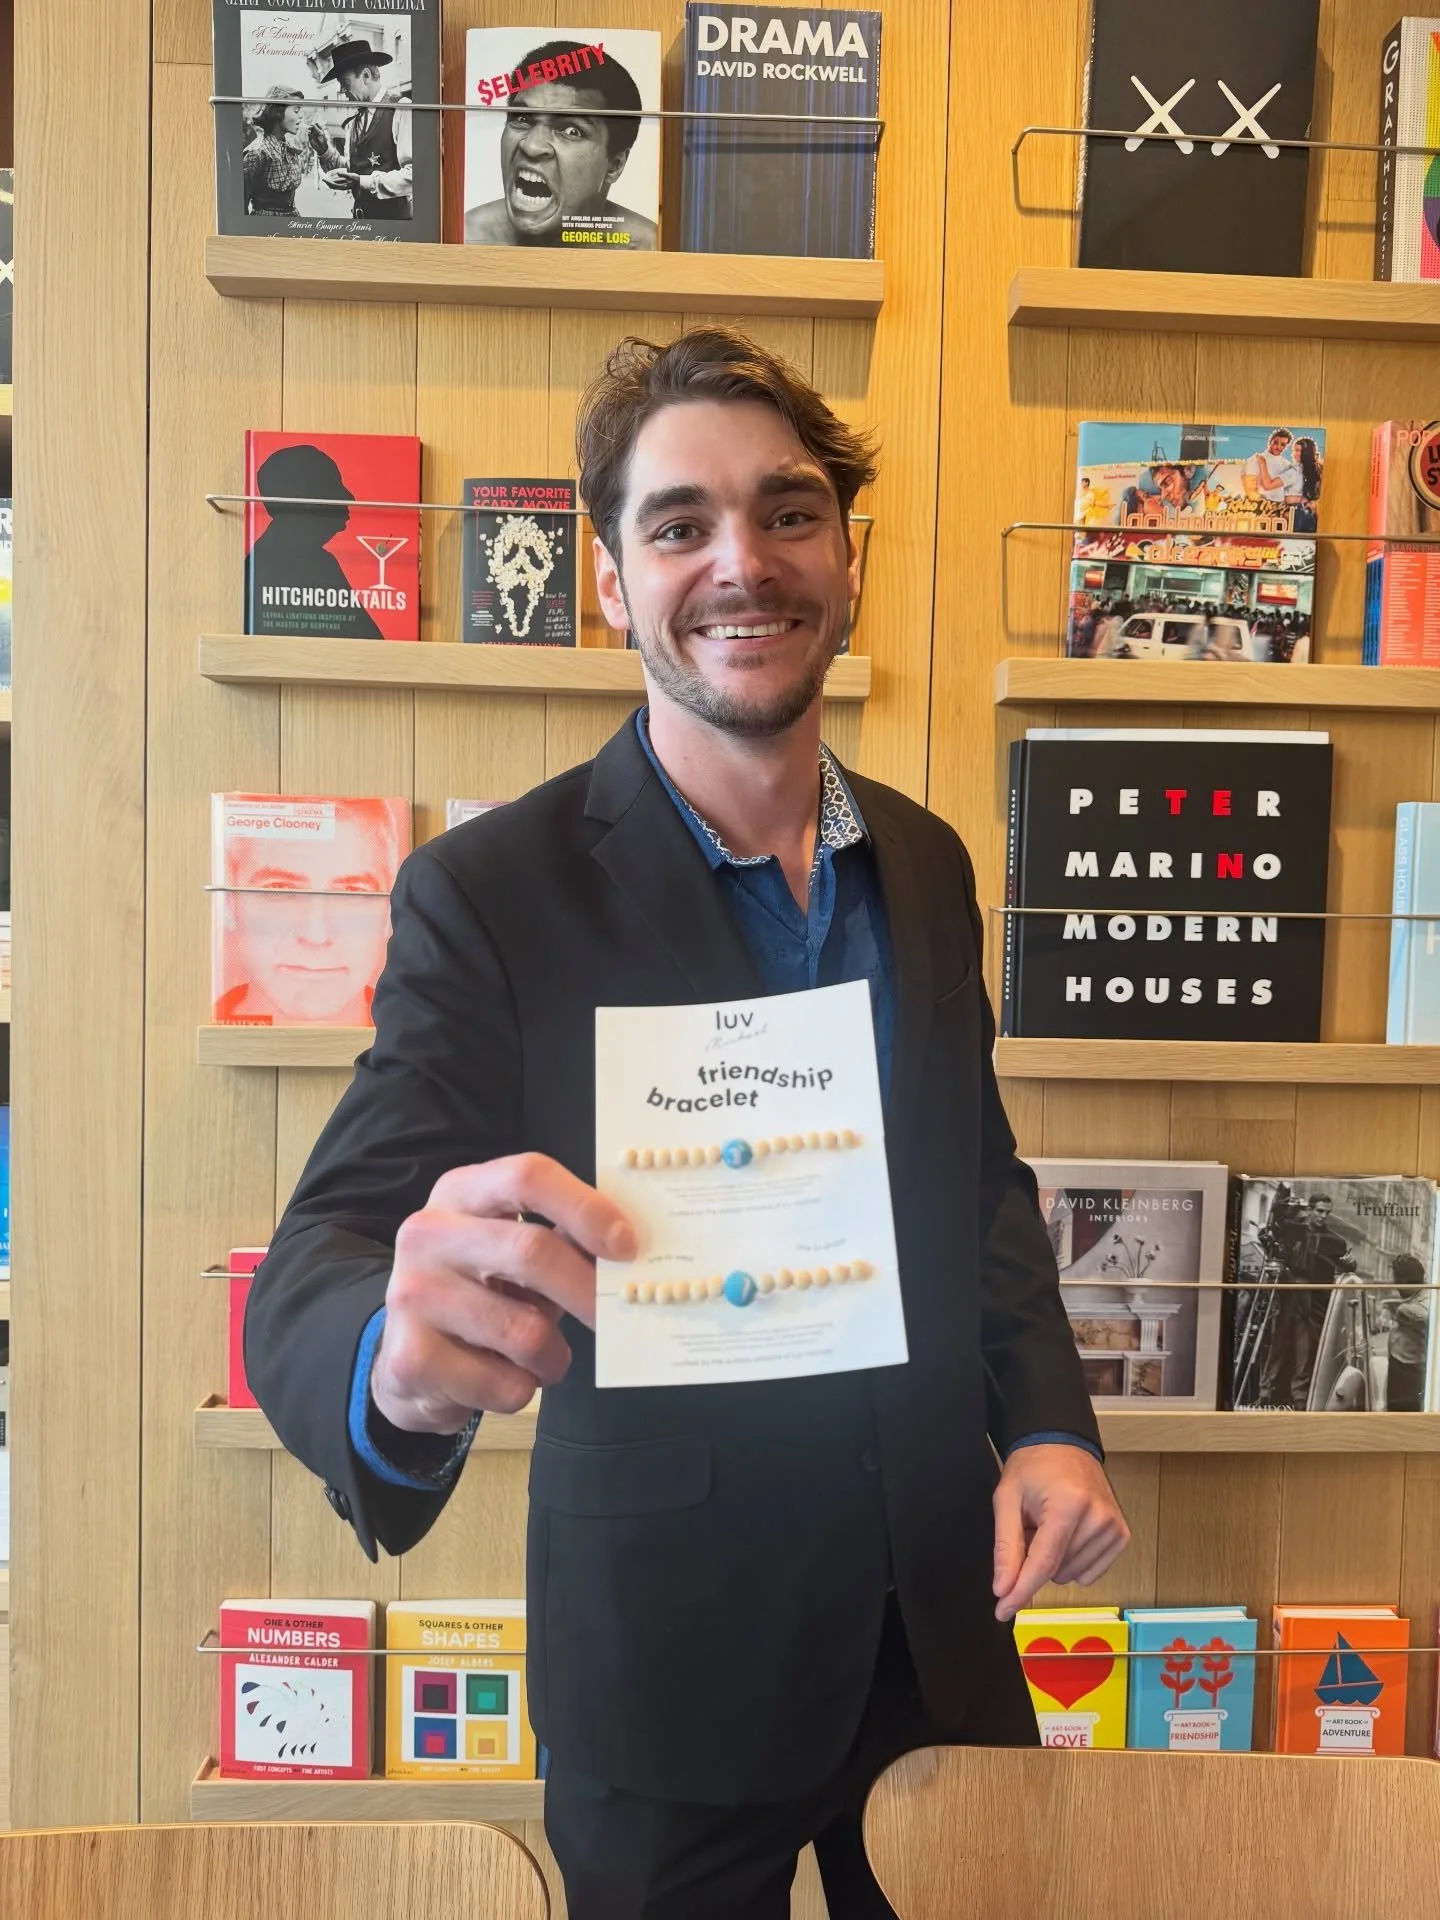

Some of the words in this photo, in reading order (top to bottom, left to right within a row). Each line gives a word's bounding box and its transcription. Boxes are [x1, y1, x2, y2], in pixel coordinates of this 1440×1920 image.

[269, 26, 316, 42] Daughter
[697, 15, 870, 59] DRAMA
[252, 43, 307, 57] Remembers
[697, 60, 757, 78] DAVID
[762, 63, 868, 83] ROCKWELL
[561, 230, 604, 243] GEORGE
[606, 232, 631, 244] LOIS
[472, 486, 507, 498] YOUR
[511, 487, 571, 499] FAVORITE
[262, 586, 406, 611] HITCHCOCKTAILS
[1069, 788, 1281, 817] PETER
[226, 815, 271, 829] George
[273, 817, 321, 831] Clooney
[1064, 851, 1282, 880] MARINO
[1062, 914, 1278, 943] MODERN
[1065, 976, 1273, 1006] HOUSES
[715, 1010, 754, 1030] luv
[697, 1060, 834, 1091] friendship
[645, 1086, 760, 1114] bracelet
[1046, 1197, 1096, 1209] DAVID
[1103, 1198, 1194, 1212] KLEINBERG
[1353, 1201, 1421, 1217] Truffaut
[1089, 1214, 1149, 1224] INTERIORS
[264, 1617, 281, 1627] ONE
[285, 1619, 292, 1627] &
[294, 1620, 324, 1629] OTHER
[419, 1619, 462, 1630] SQUARES
[464, 1622, 471, 1630] &
[472, 1622, 504, 1631] OTHER
[247, 1627, 341, 1648] NUMBERS
[422, 1629, 501, 1648] SHAPES
[249, 1652, 301, 1666] ALEXANDER
[304, 1656, 339, 1668] CALDER
[1046, 1733, 1088, 1747] LOVE
[1170, 1732, 1220, 1741] FRIENDSHIP
[1322, 1728, 1371, 1737] ADVENTURE
